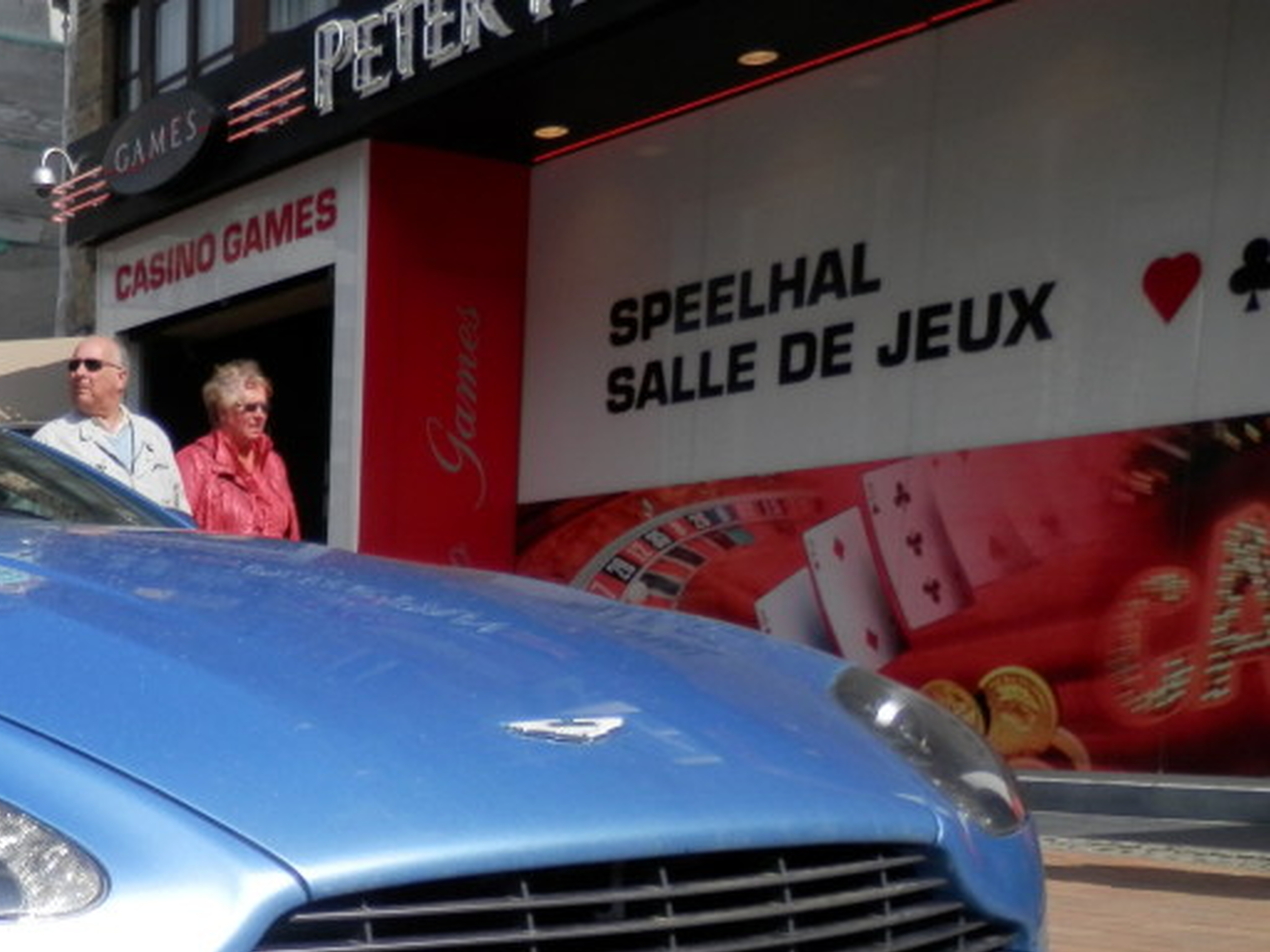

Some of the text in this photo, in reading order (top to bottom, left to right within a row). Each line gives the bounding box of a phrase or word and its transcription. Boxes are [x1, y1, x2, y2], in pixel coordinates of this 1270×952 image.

[314, 0, 514, 116] PETER
[114, 107, 197, 174] GAMES
[115, 187, 338, 301] CASINO GAMES
[609, 242, 882, 347] SPEELHAL
[606, 281, 1057, 414] SALLE DE JEUX
[426, 304, 487, 510] Games
